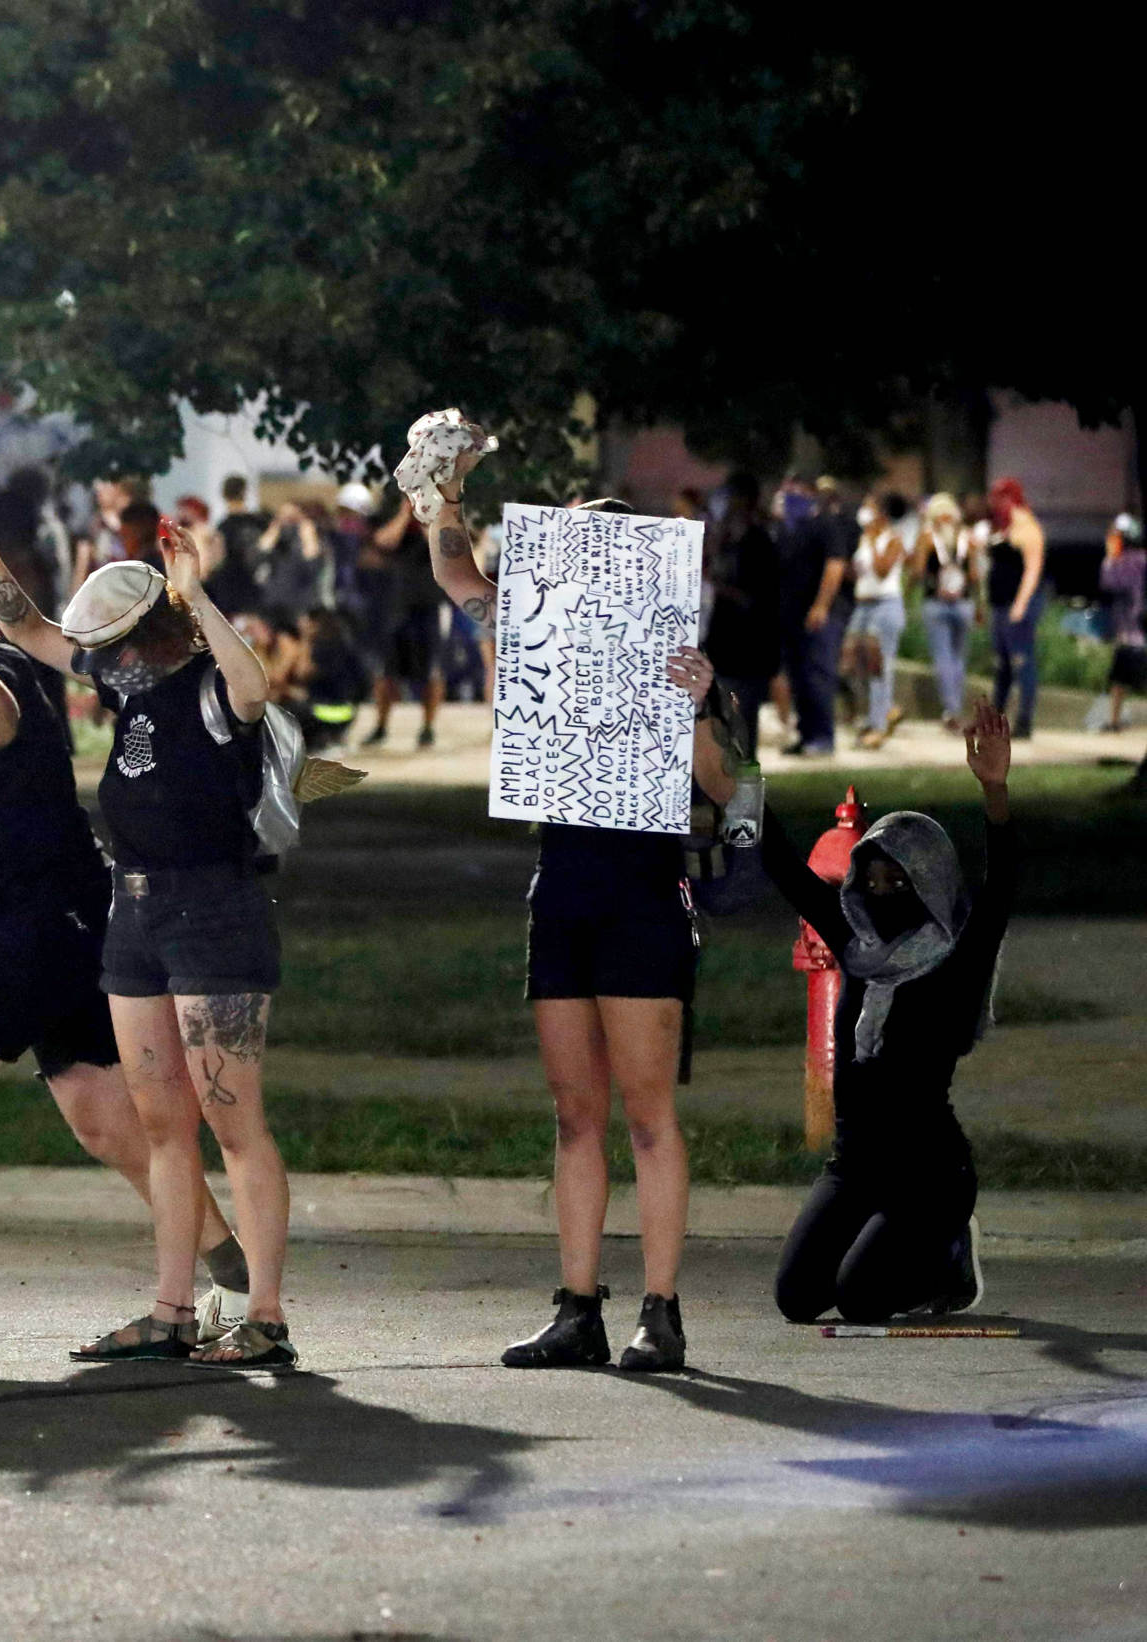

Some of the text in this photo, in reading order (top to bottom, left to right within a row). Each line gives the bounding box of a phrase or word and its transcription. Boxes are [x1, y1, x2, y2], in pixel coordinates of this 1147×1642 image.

[514, 533, 524, 562] STAY
[537, 532, 547, 569] TOPIC
[581, 527, 590, 577] YOU HAVE
[591, 517, 603, 585] THE RIGHT
[614, 520, 623, 539] THE
[625, 544, 633, 552] A
[613, 556, 622, 596] SILENT
[624, 577, 634, 606] RIGHT
[636, 557, 644, 600] LAWYER
[655, 620, 665, 636] OR
[508, 625, 520, 684] ALLIES:
[573, 609, 592, 724] PROTECT BLACK
[591, 649, 604, 706] BODIES
[638, 650, 650, 698] DO NOT
[652, 641, 664, 688] PHOTOS
[664, 620, 677, 690] PSTORS
[607, 690, 613, 698] A
[674, 691, 686, 717] FAC
[663, 716, 673, 757] VIDEO
[523, 735, 542, 806] BLACK
[542, 738, 561, 810] VOICES
[592, 741, 614, 818] DO NOT
[615, 739, 628, 826] TONE POLICE
[628, 720, 642, 827] BLACK PROTESTORS
